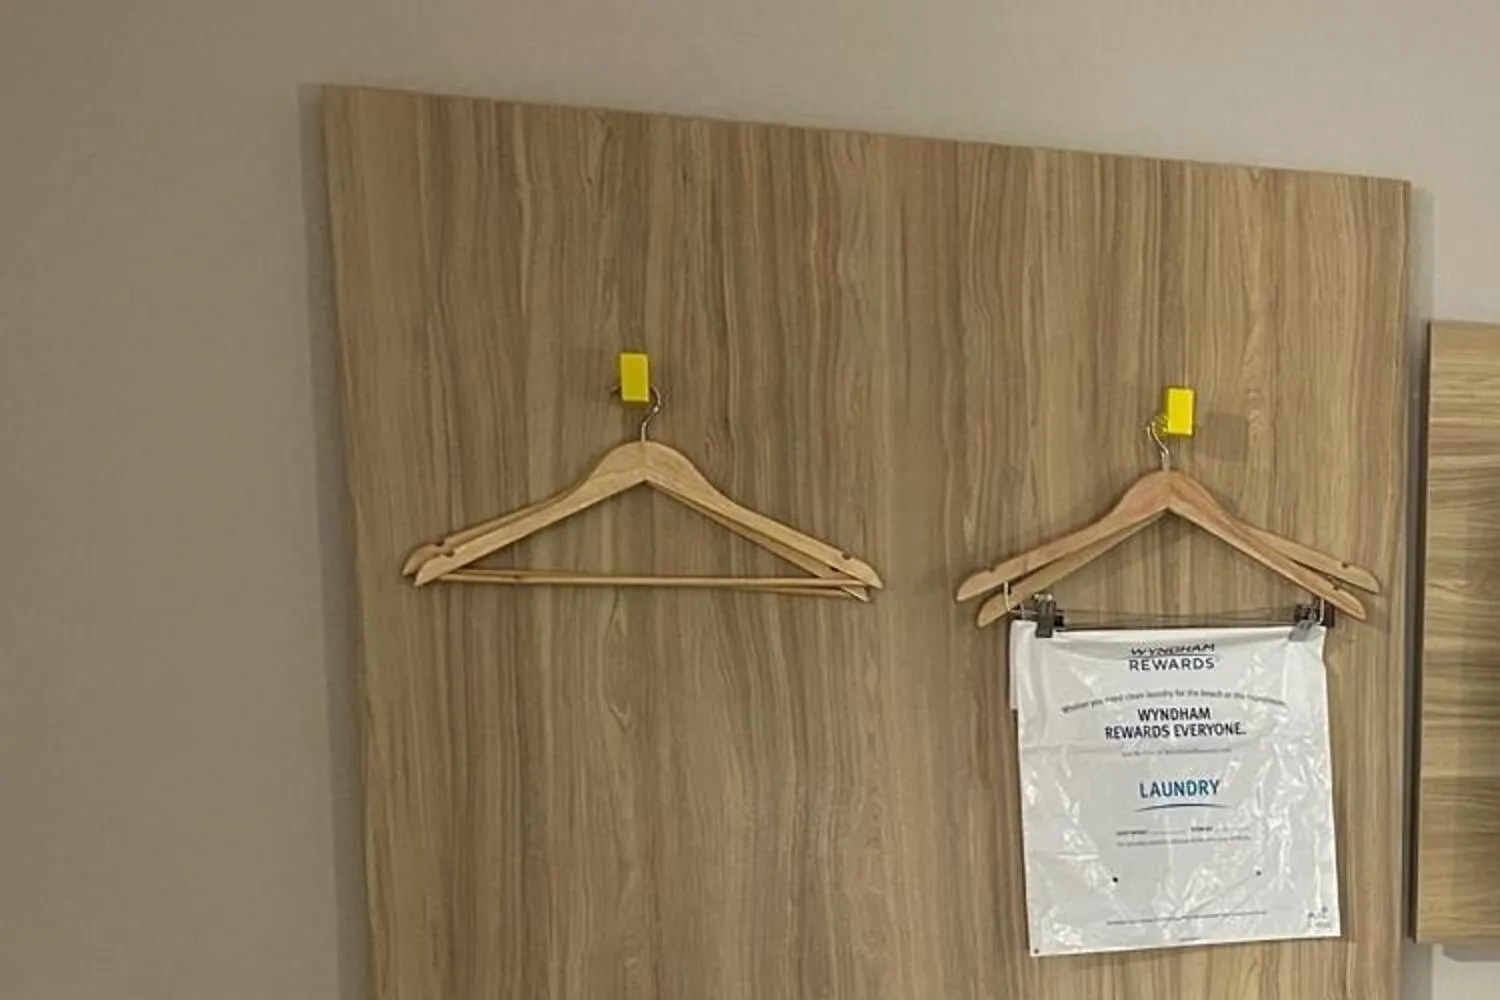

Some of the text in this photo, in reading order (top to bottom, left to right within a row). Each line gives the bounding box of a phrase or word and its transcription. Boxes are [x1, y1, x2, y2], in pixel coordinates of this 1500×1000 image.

[1129, 657, 1215, 671] REWARDS
[1137, 706, 1211, 722] WYNDHAM
[1104, 721, 1247, 740] REWARDS EVERYONE.
[1139, 778, 1221, 799] LAUNDRY
